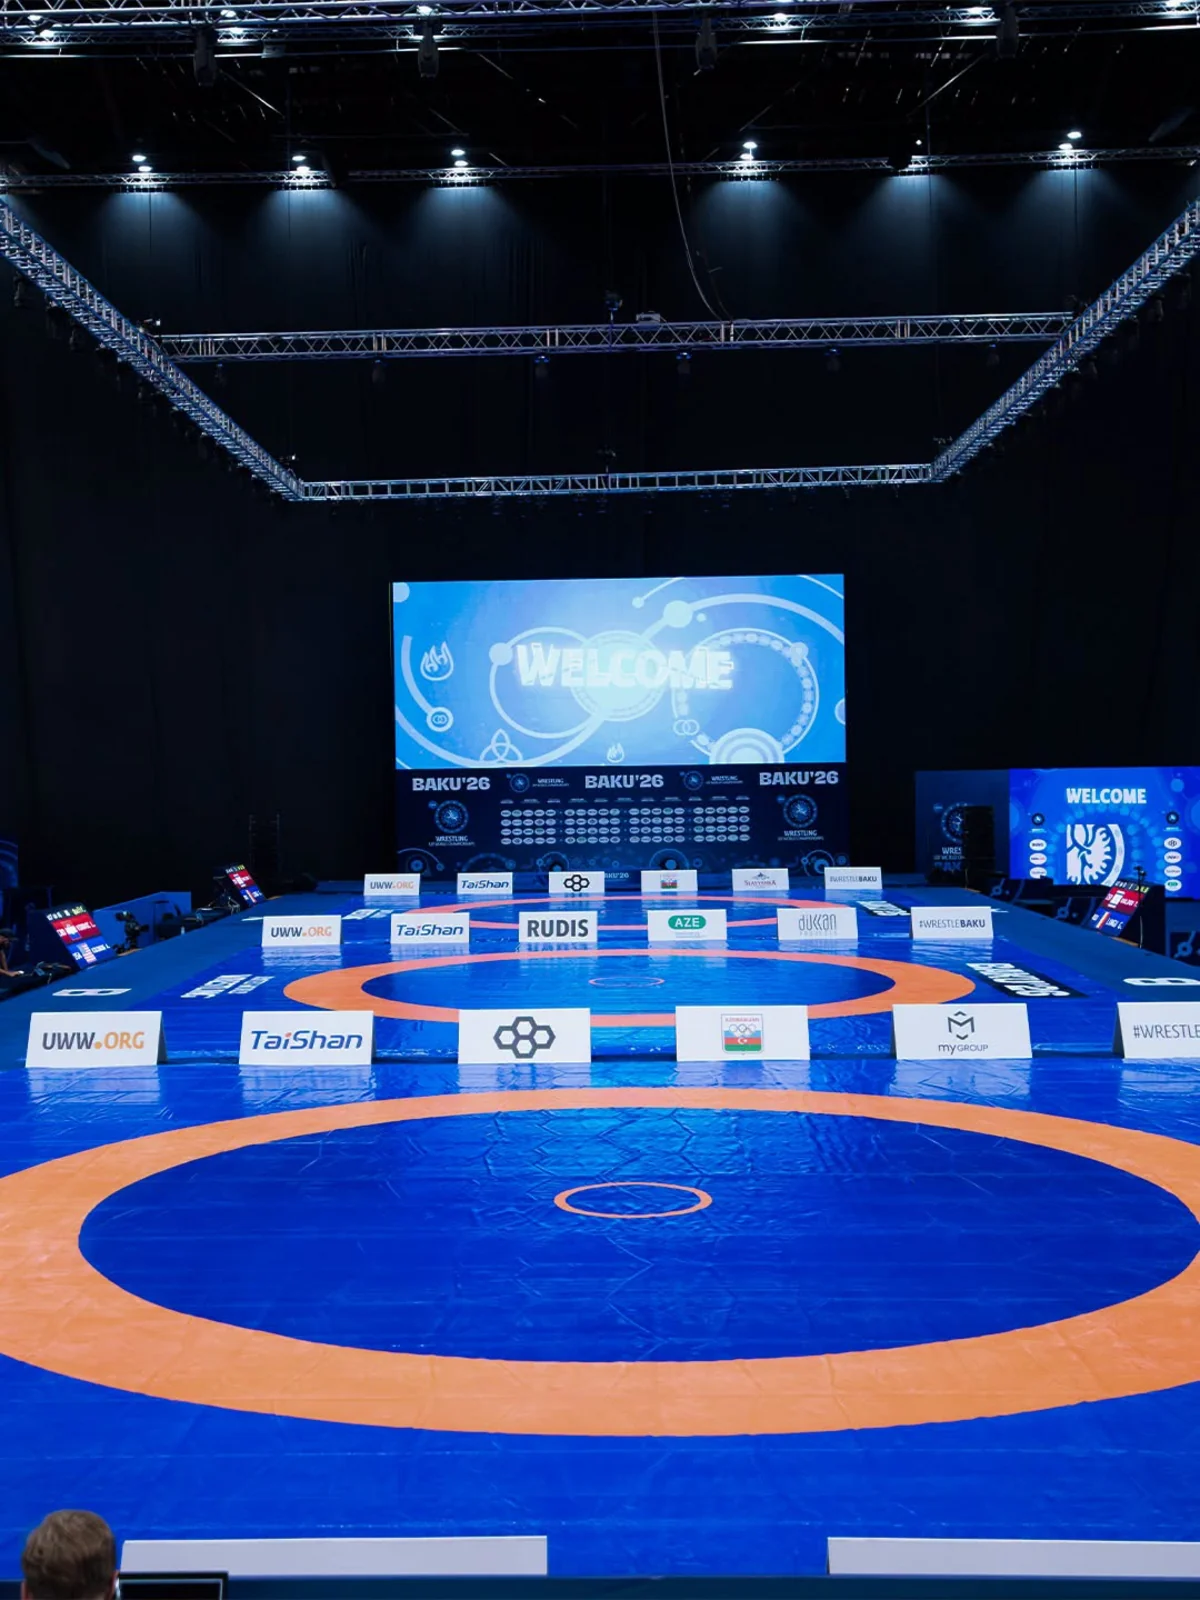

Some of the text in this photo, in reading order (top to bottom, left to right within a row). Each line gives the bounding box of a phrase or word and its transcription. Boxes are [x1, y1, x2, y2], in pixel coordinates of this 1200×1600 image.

[516, 643, 734, 690] WELCOME
[412, 777, 491, 791] BAKU'26
[585, 774, 664, 789] BAKU'26
[759, 771, 839, 786] BAKU'26
[1066, 788, 1147, 804] WELCOME
[370, 881, 414, 889] UWW.ORG
[461, 880, 509, 889] TaiShan
[527, 919, 589, 938] RUDIS
[674, 917, 700, 928] AZE
[919, 919, 986, 929] #WRESTLEBAKU
[270, 926, 332, 938] UWW.ORG
[396, 924, 464, 936] TaiShan
[42, 1031, 145, 1050] UWW.ORG
[251, 1030, 363, 1050] TaiShan
